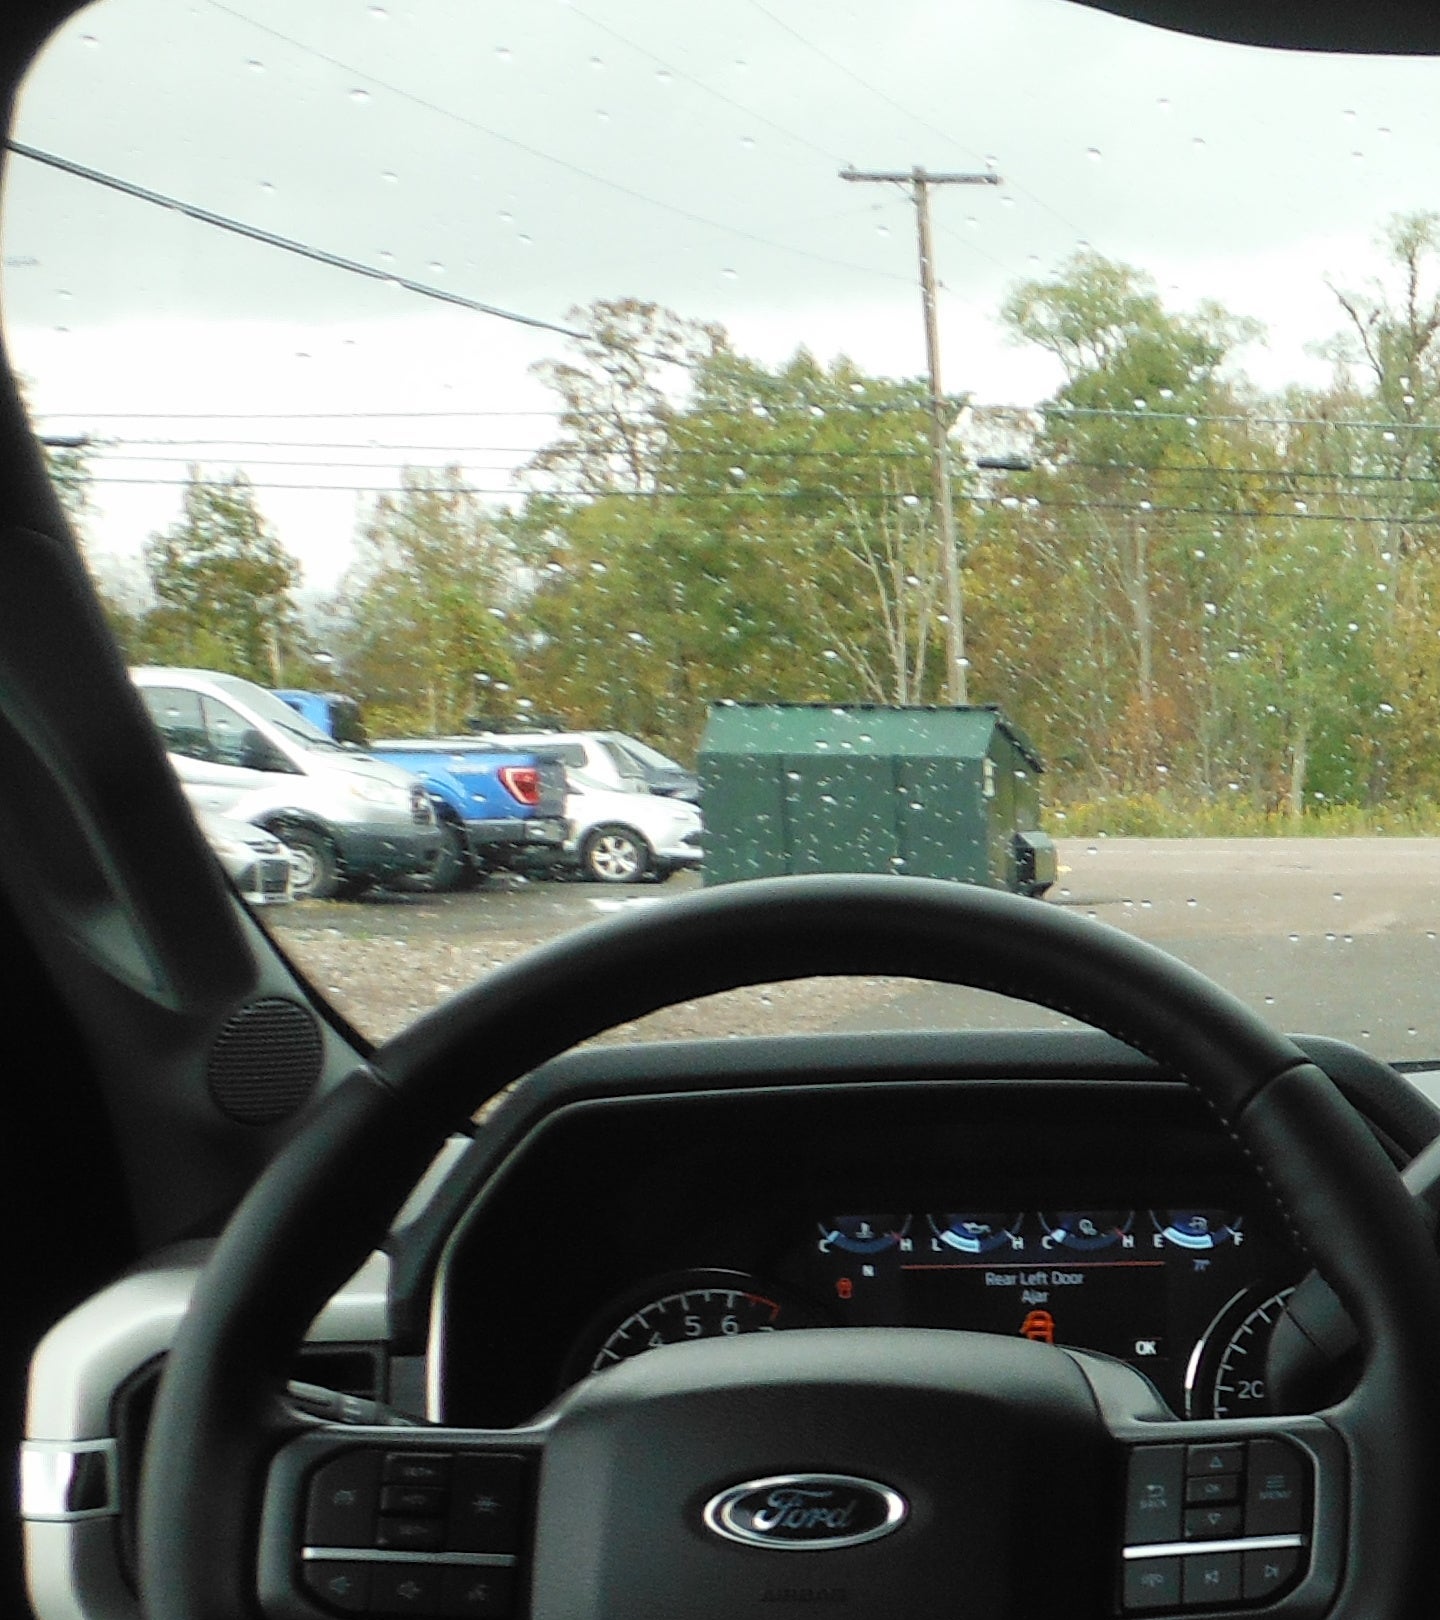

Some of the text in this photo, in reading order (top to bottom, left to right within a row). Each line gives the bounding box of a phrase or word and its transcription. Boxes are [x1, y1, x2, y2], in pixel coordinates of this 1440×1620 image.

[818, 1239, 831, 1253] C
[900, 1239, 912, 1253] H
[931, 1239, 942, 1253] L
[1012, 1237, 1024, 1250] H
[1122, 1235, 1134, 1249] H
[1153, 1235, 1164, 1249] E
[1233, 1233, 1244, 1246] F
[985, 1271, 1084, 1286] Rear Left Door
[1021, 1289, 1050, 1305] Ajar
[683, 1314, 702, 1337] 5
[721, 1314, 740, 1335] 6
[1135, 1341, 1157, 1356] OK
[752, 1488, 857, 1531] Ford
